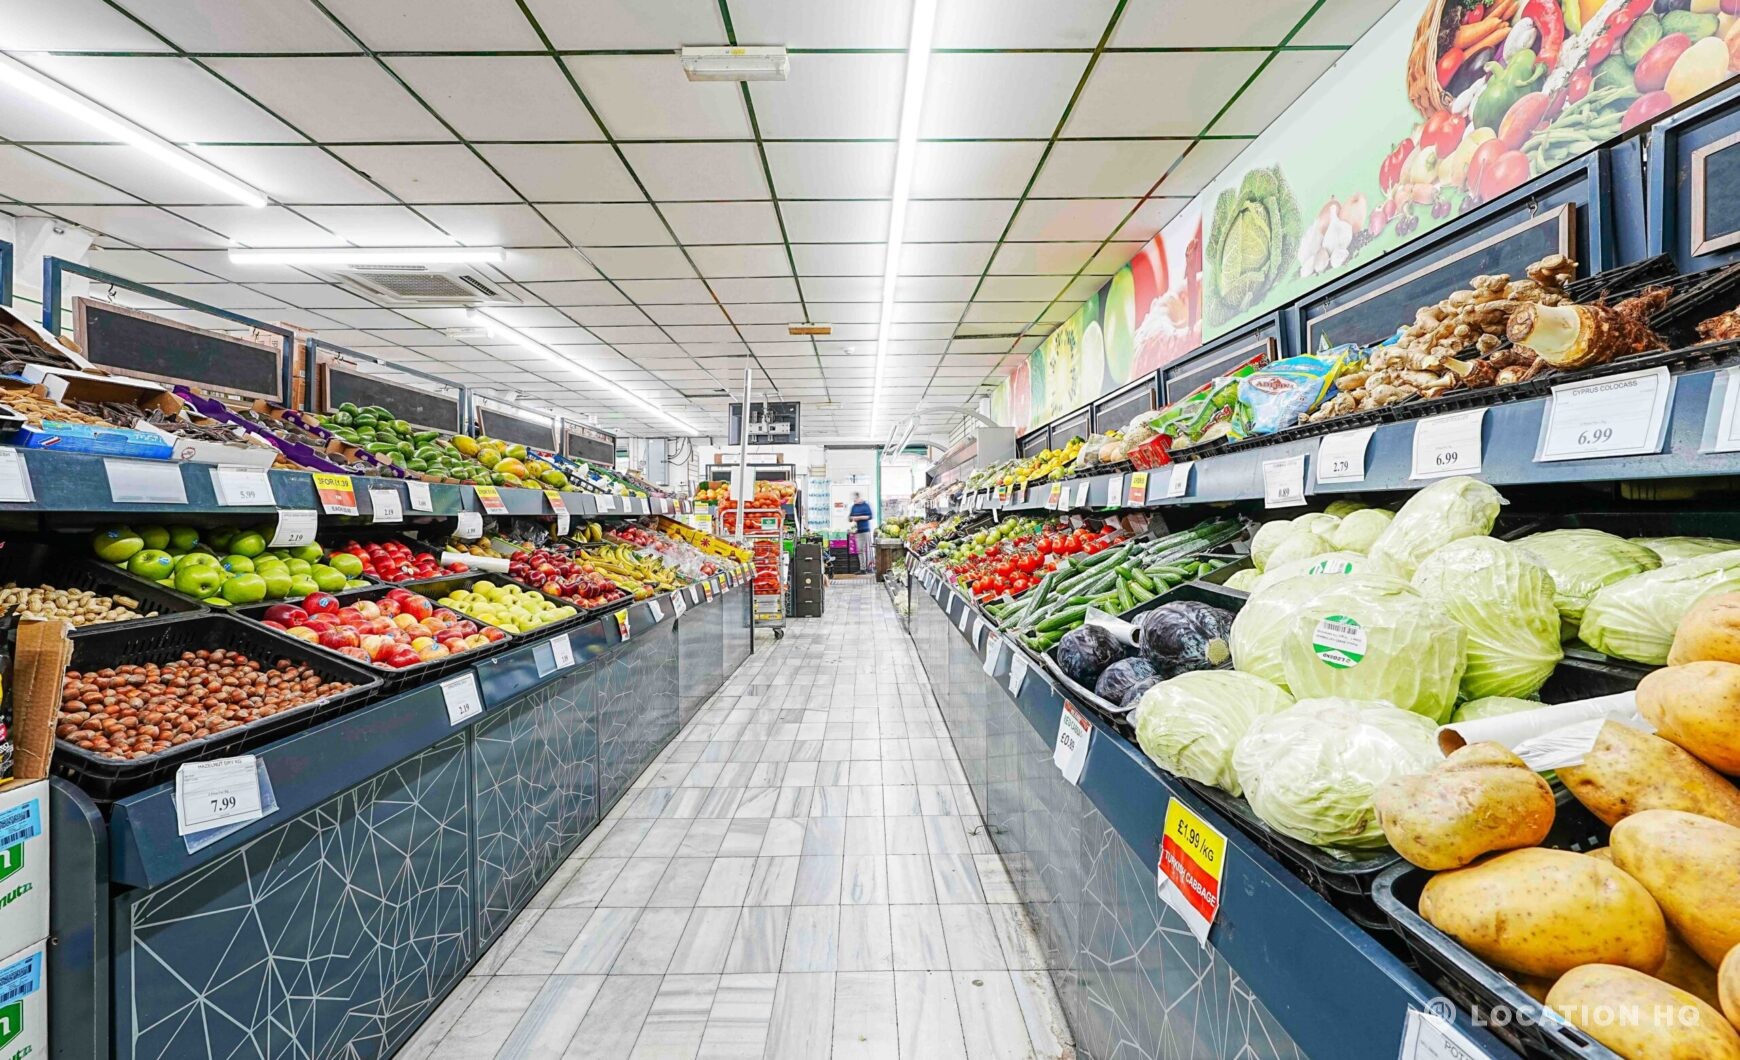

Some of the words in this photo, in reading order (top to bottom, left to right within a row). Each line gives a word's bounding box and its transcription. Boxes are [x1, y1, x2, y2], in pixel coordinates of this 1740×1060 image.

[1572, 386, 1599, 397] CYPRUS
[1600, 380, 1638, 392] COLOCASS
[1577, 427, 1613, 446] 6.99
[1333, 461, 1349, 472] 2.79
[1436, 451, 1458, 466] 6.99
[240, 490, 256, 499] 5.99
[288, 534, 303, 542] 2.19
[458, 703, 470, 715] 2.19
[211, 796, 236, 813] 7.99
[1177, 819, 1200, 848] £1.99
[1185, 872, 1217, 908] CABBAGE
